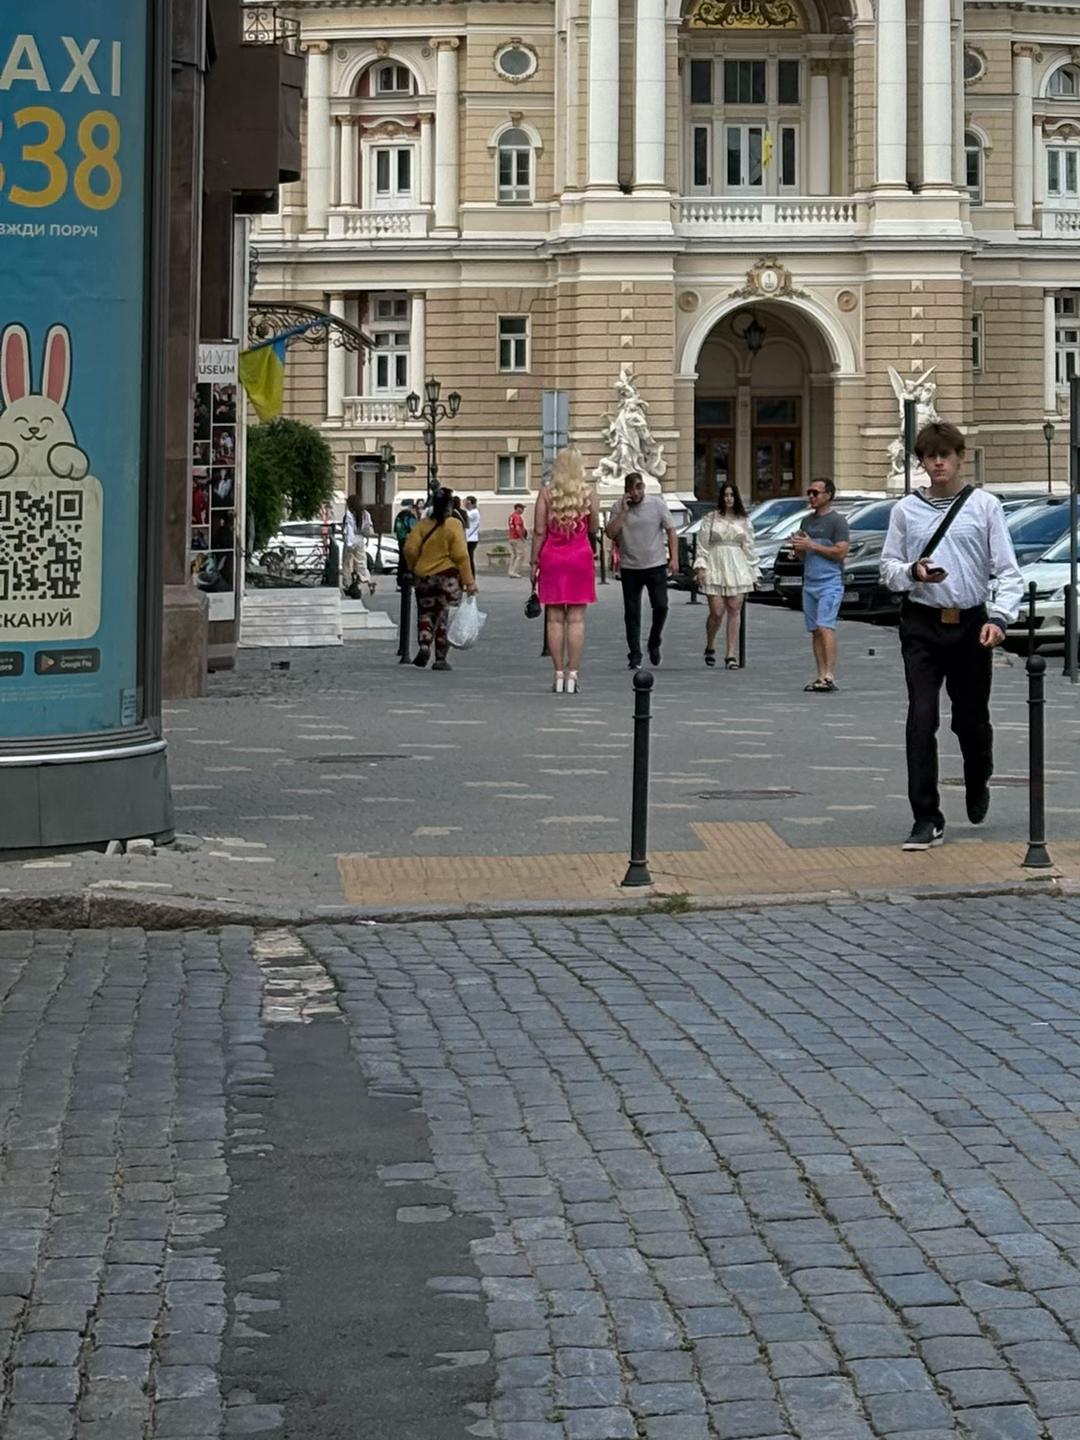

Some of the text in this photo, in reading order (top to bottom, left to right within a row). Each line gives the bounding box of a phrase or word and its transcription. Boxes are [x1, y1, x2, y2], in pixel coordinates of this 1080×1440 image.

[0, 34, 121, 96] AXI
[0, 106, 122, 210] 38
[50, 224, 98, 237] ПОРУЧ
[200, 365, 235, 375] USEUM
